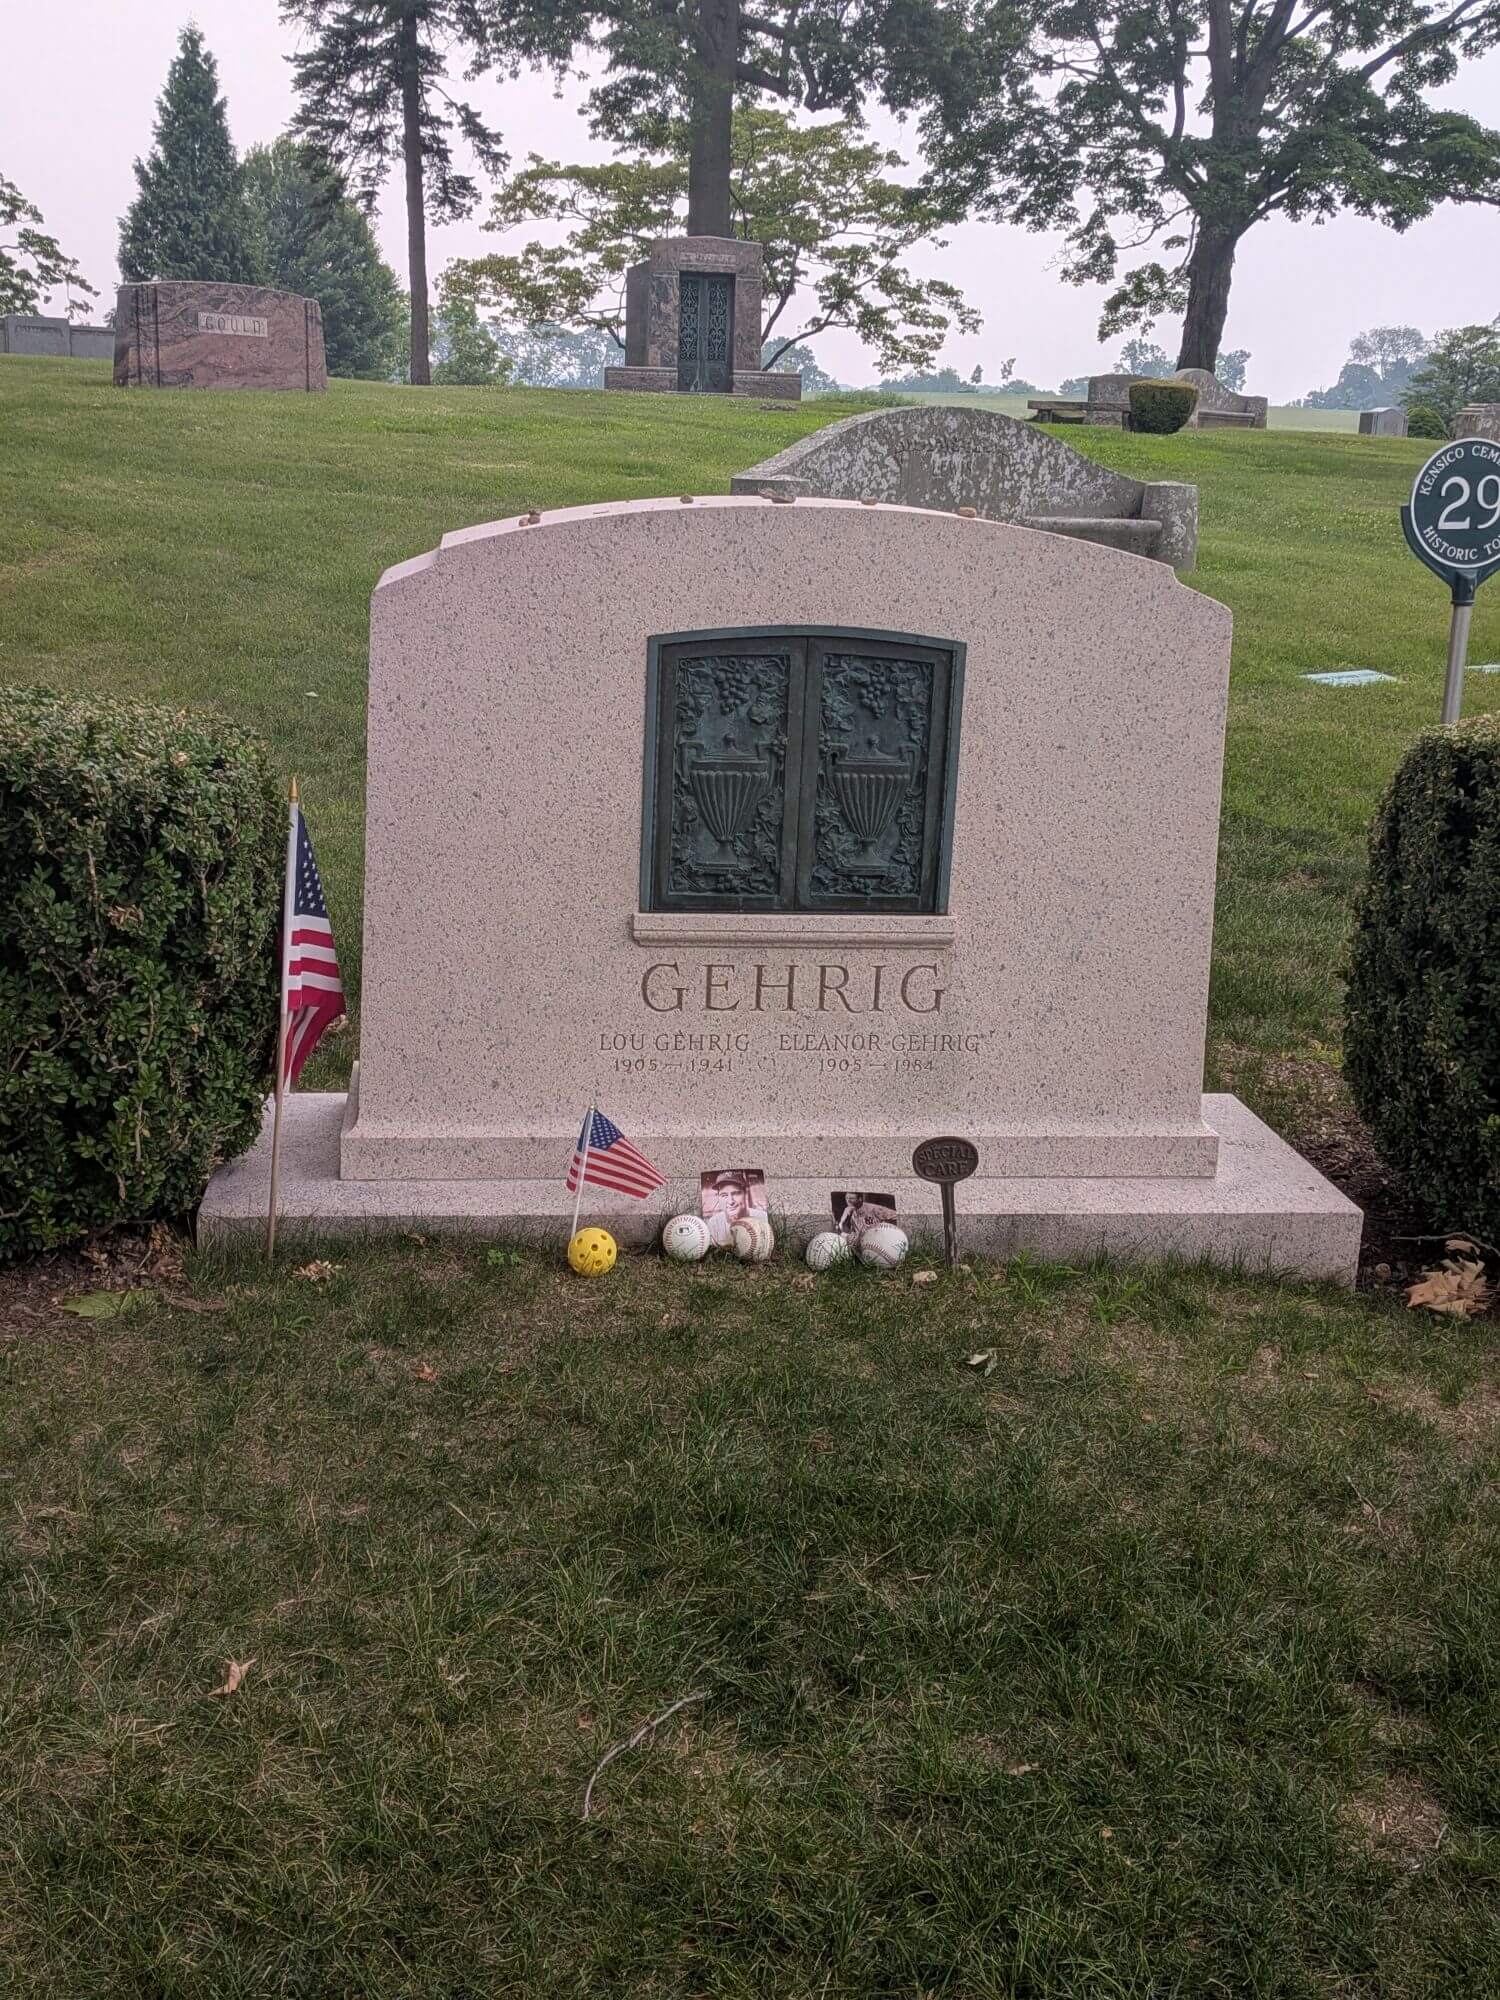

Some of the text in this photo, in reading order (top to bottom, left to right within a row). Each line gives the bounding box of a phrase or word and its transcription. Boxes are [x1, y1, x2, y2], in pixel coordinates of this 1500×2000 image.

[205, 315, 262, 335] GOULD
[1419, 447, 1465, 496] KENSICO
[1437, 474, 1500, 530] 29
[1422, 525, 1500, 561] HISTORIC TO
[640, 962, 946, 1014] GEHRIG
[600, 1033, 750, 1052] LOU GEHRIG
[779, 1034, 981, 1053] ELEANOR GEHRIG
[614, 1058, 658, 1073] 1905
[689, 1058, 733, 1072] 1941
[819, 1058, 862, 1072] 1905
[894, 1058, 934, 1072] 1984
[919, 1144, 975, 1162] SPECIAL
[923, 1160, 968, 1176] CARE
